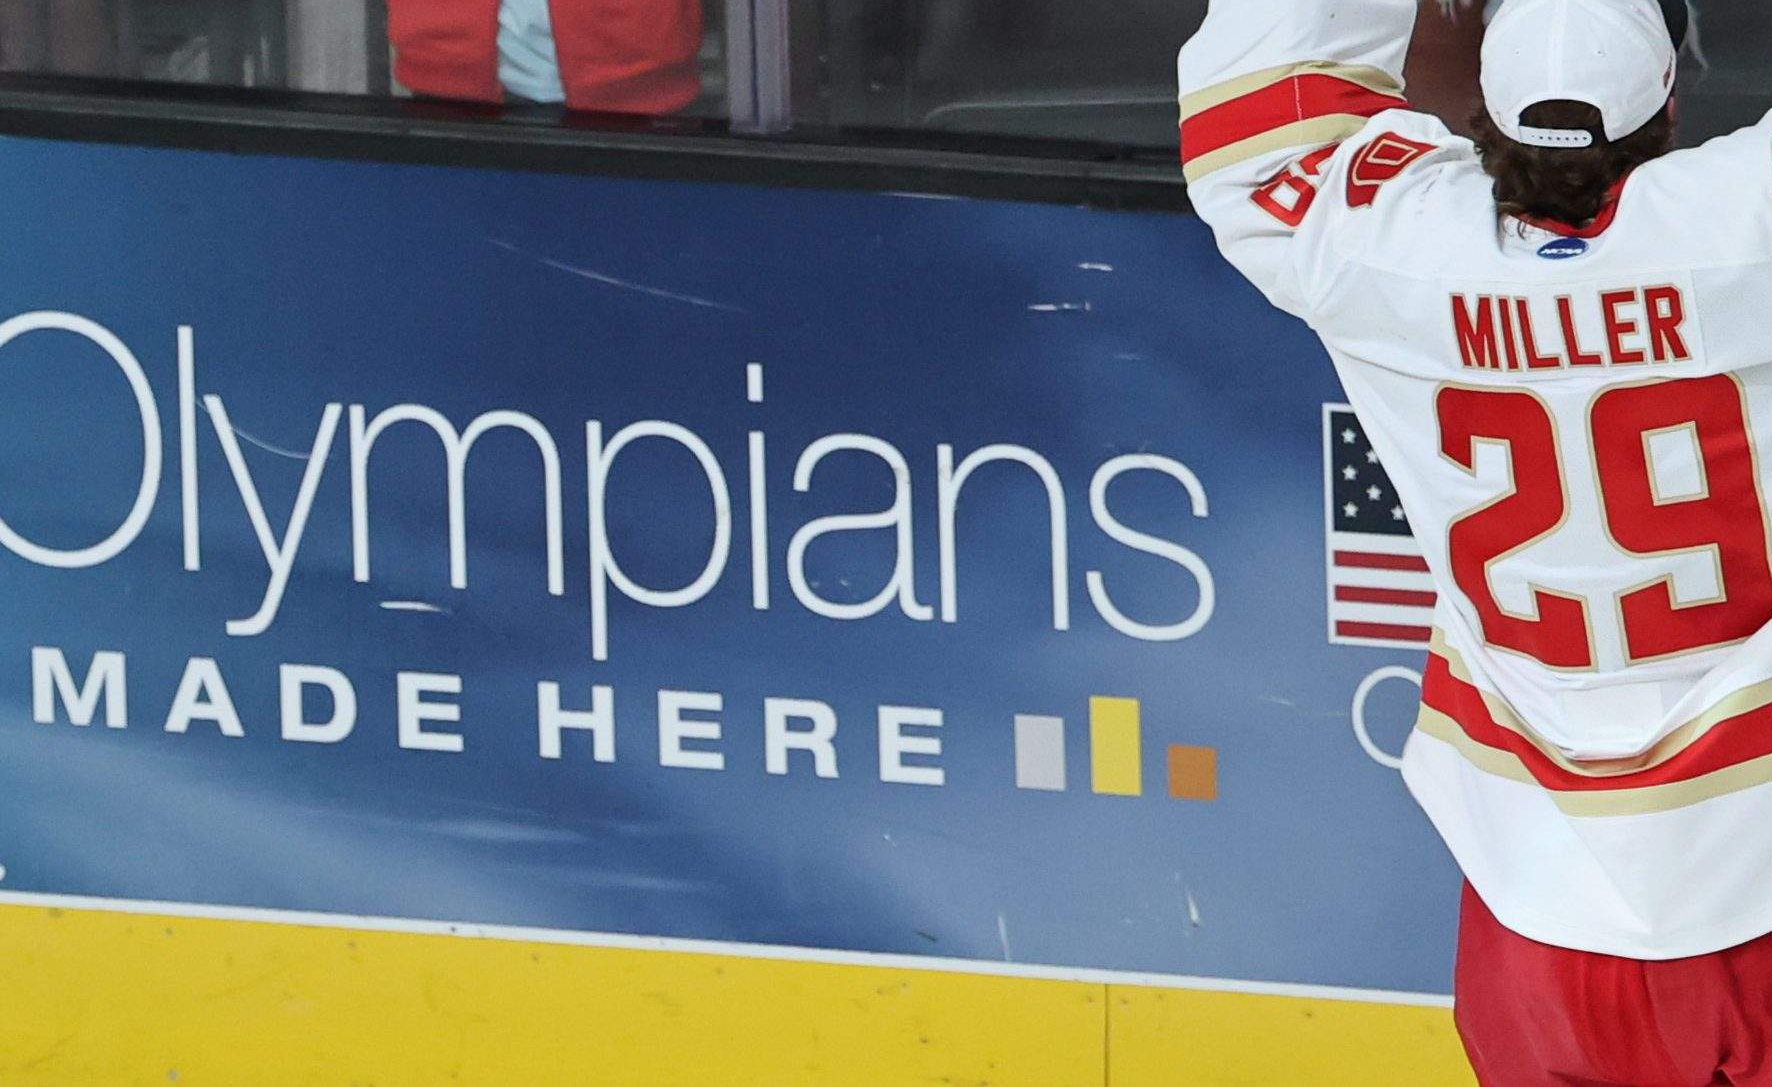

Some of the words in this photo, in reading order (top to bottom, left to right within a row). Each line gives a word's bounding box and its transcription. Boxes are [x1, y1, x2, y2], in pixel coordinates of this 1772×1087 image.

[1449, 284, 1694, 372] MILLER
[0, 309, 1217, 662] Olympians
[31, 645, 465, 753] MADE
[536, 680, 946, 787] HERE
